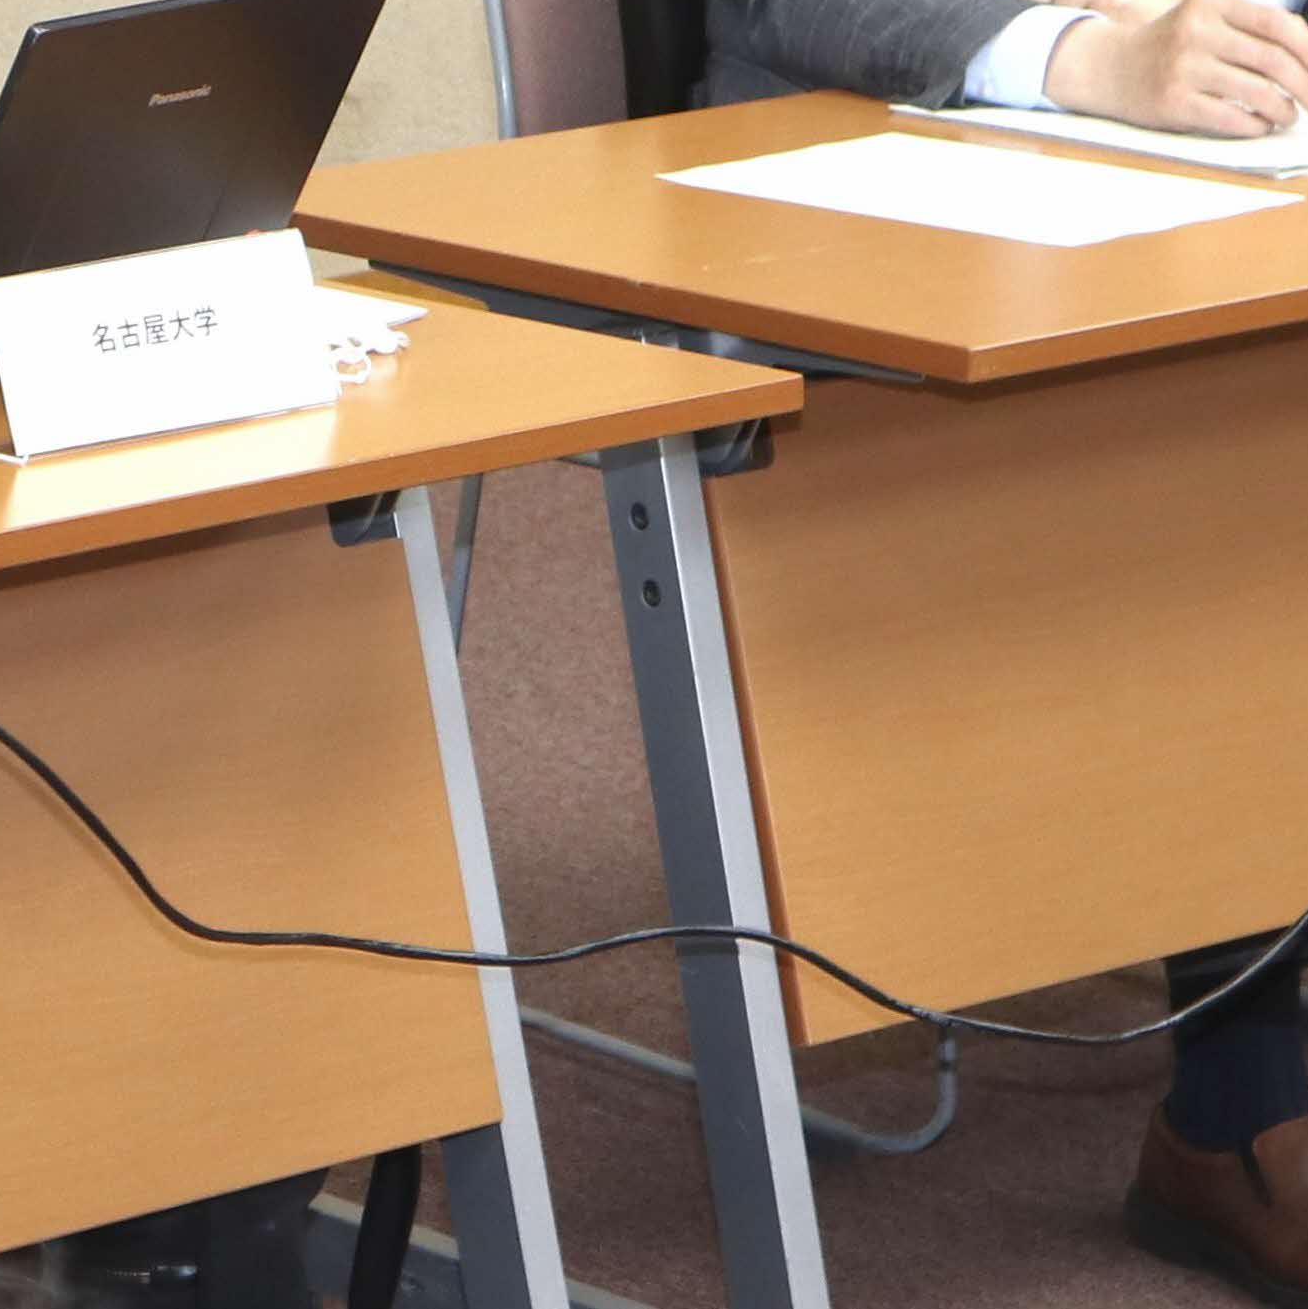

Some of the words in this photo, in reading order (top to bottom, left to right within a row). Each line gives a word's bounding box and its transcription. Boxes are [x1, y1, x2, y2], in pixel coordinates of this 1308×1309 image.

[92, 304, 218, 354] 名古屋大学
